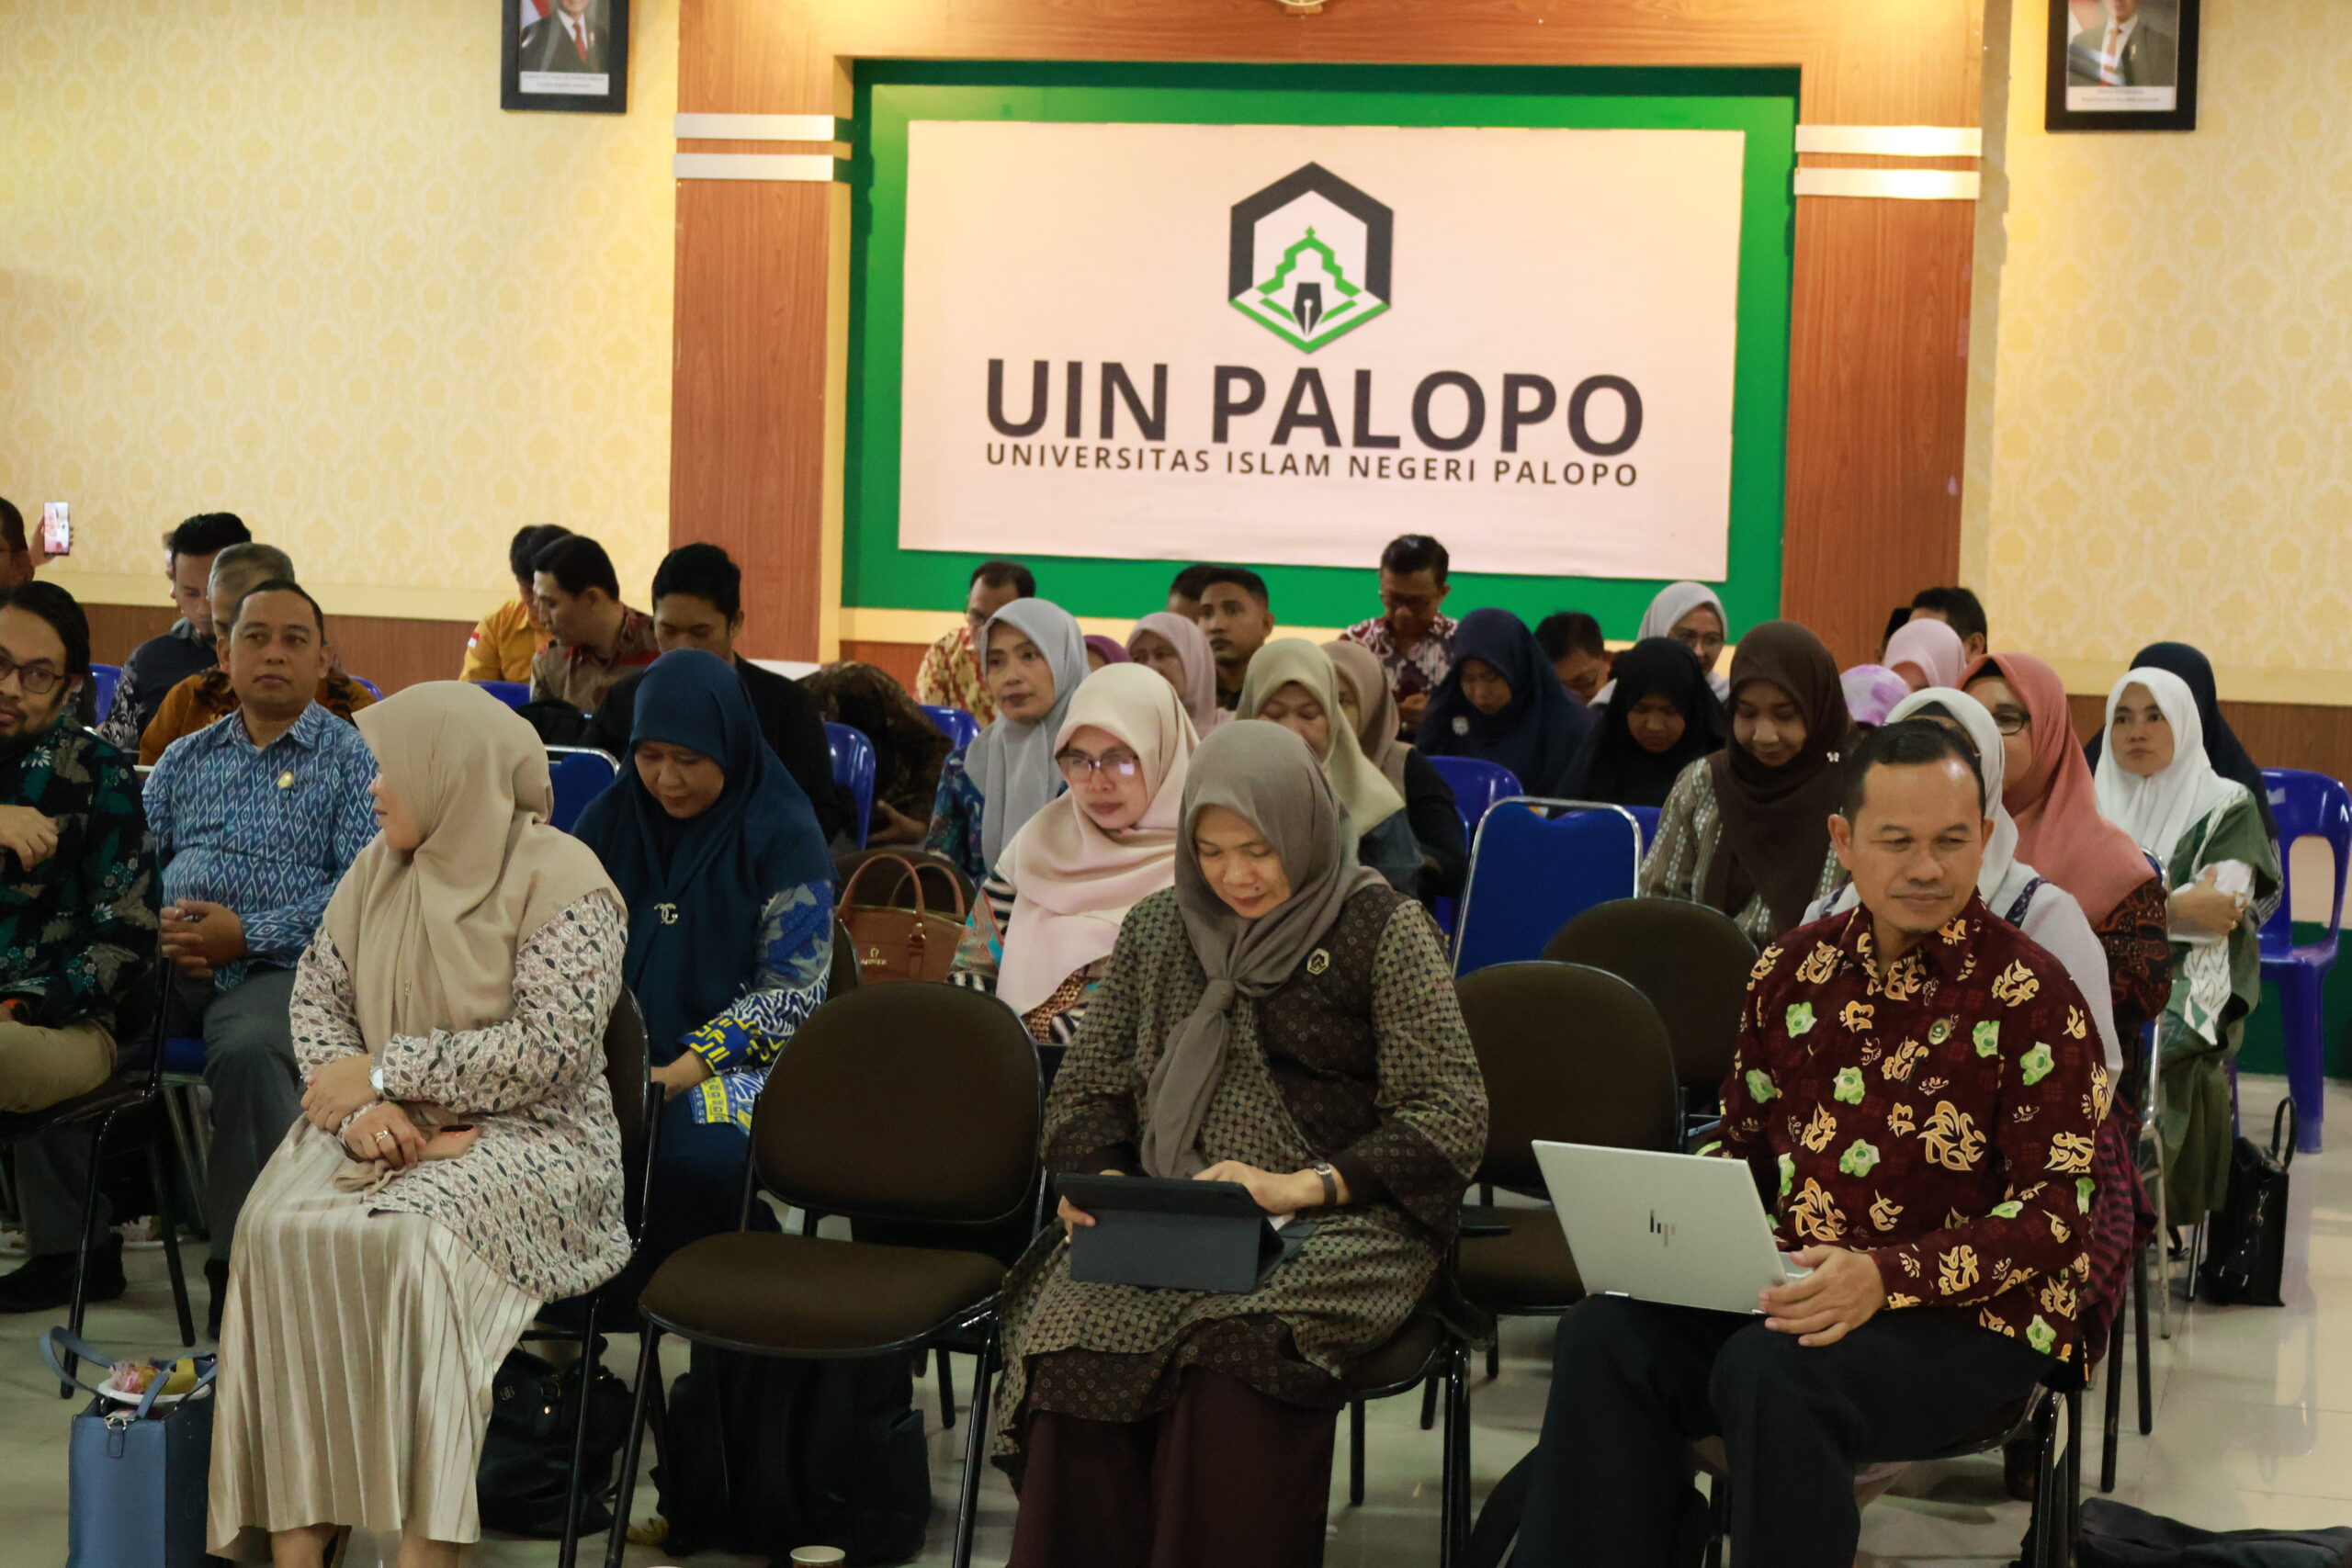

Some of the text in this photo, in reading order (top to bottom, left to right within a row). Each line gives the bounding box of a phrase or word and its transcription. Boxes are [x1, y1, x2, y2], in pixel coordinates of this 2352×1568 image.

[986, 358, 1644, 457] UIN PALOPO
[987, 443, 1638, 487] UNIVERSITAS ISLAM NEGERI PALOPO
